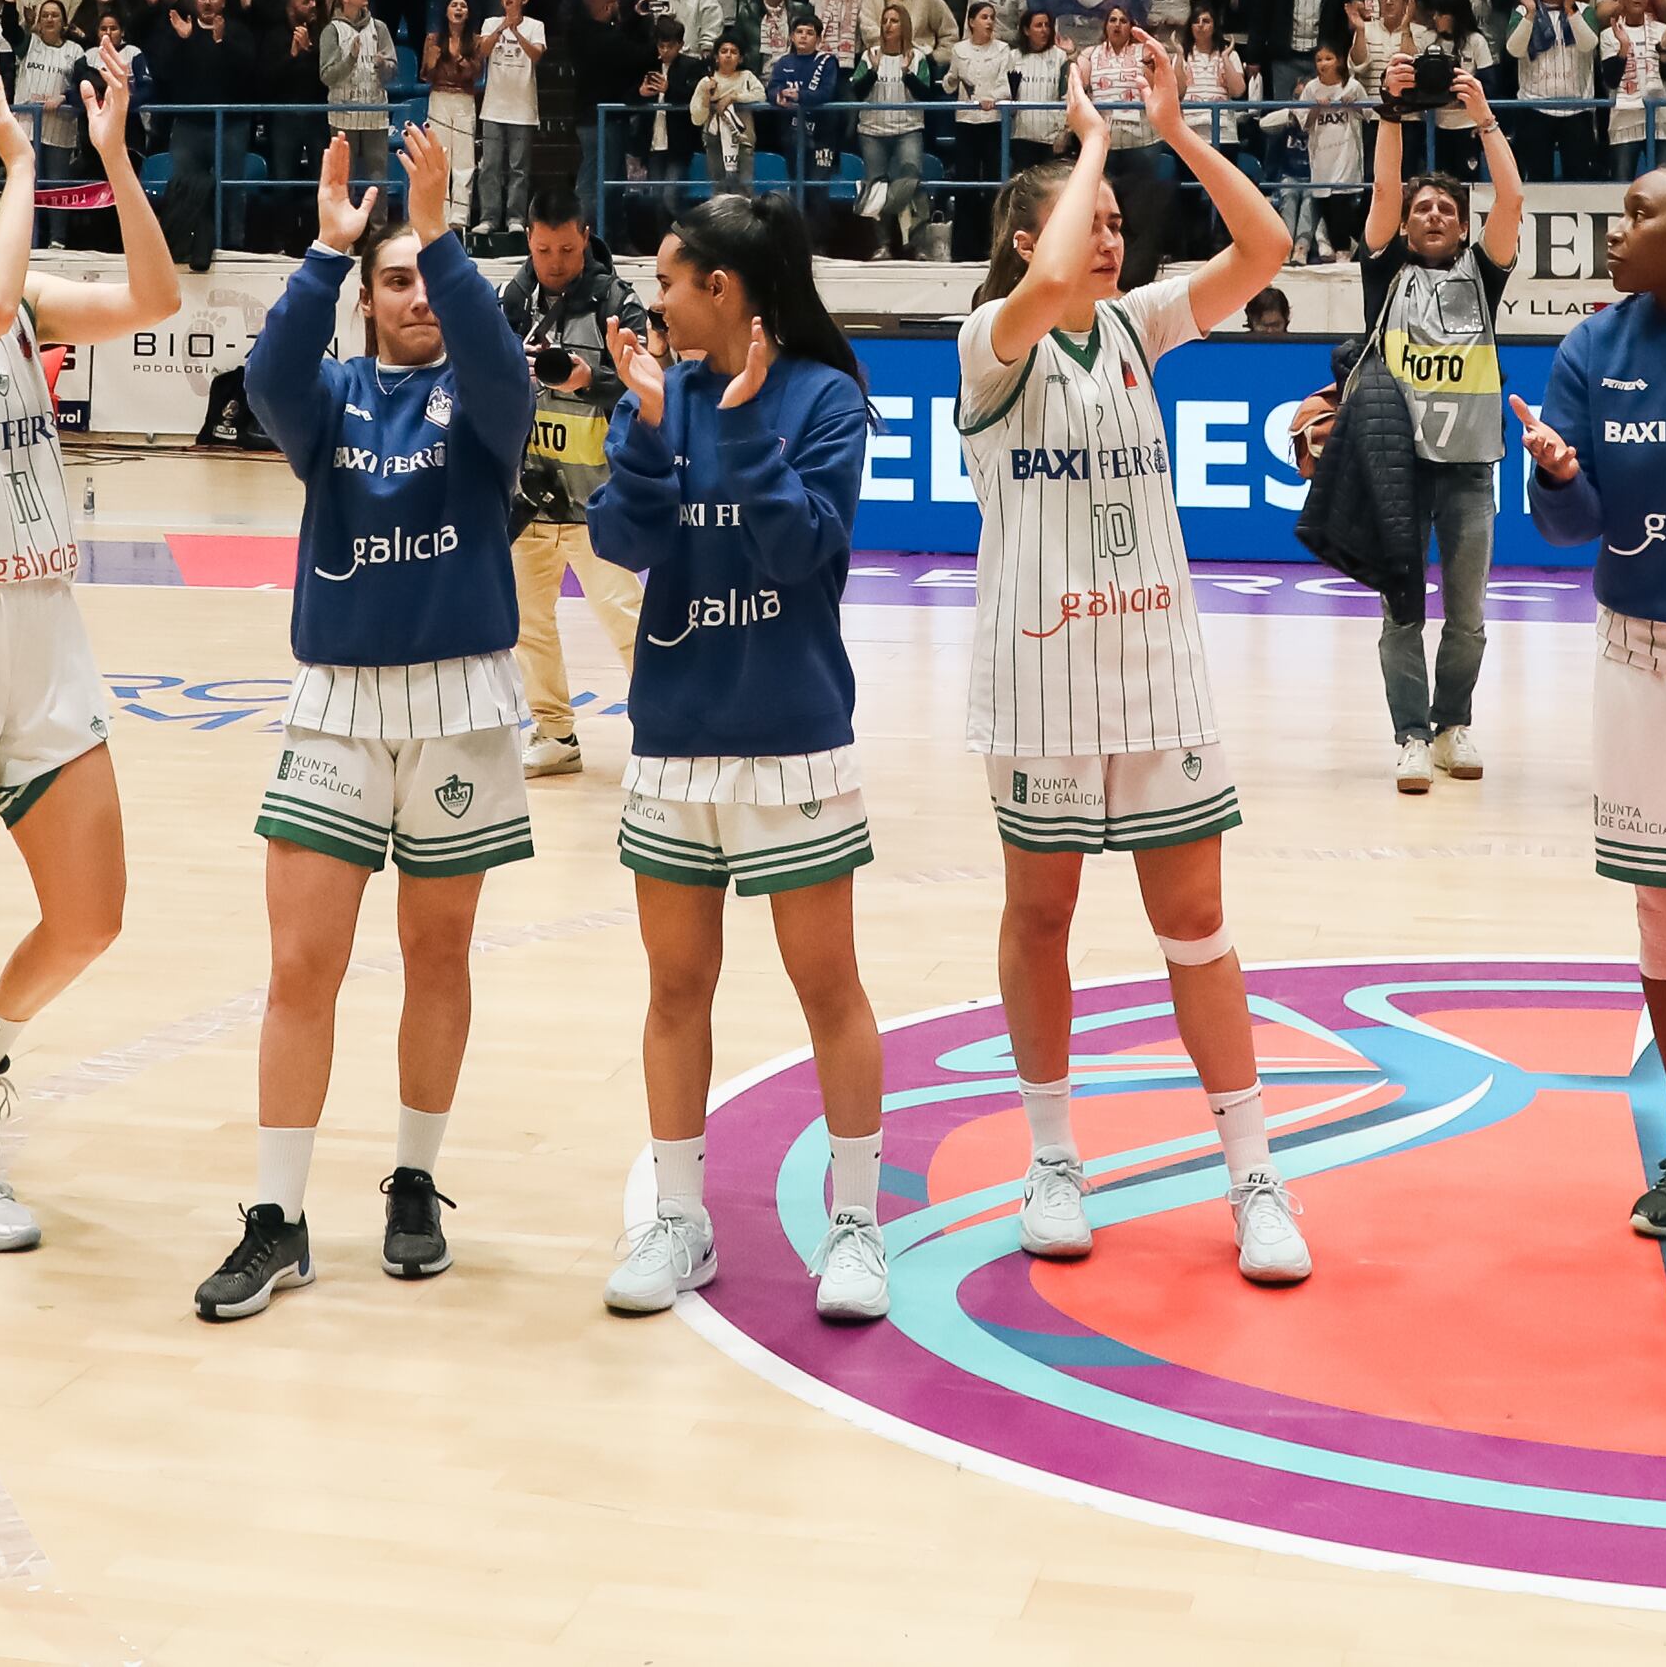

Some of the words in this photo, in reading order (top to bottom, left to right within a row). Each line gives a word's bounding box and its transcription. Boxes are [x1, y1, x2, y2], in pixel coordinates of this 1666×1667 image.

[1317, 112, 1349, 126] BAXI
[1502, 300, 1515, 315] Y
[1402, 343, 1464, 382] HOTO
[1604, 420, 1666, 444] BAXI
[334, 446, 378, 474] BAXI
[1011, 449, 1089, 481] BAXI
[1093, 502, 1136, 558] 10
[314, 524, 459, 582] galicia
[1022, 582, 1171, 638] galicia
[294, 754, 340, 779] XUNTA
[289, 768, 308, 785] DE
[310, 772, 363, 801] GALICIA
[442, 789, 468, 802] BAXI
[1032, 777, 1079, 791] XUNTA
[1031, 791, 1048, 804] DE
[1050, 791, 1105, 807] GALICIA
[1600, 801, 1642, 819] XUNTA
[1599, 814, 1615, 828] DE
